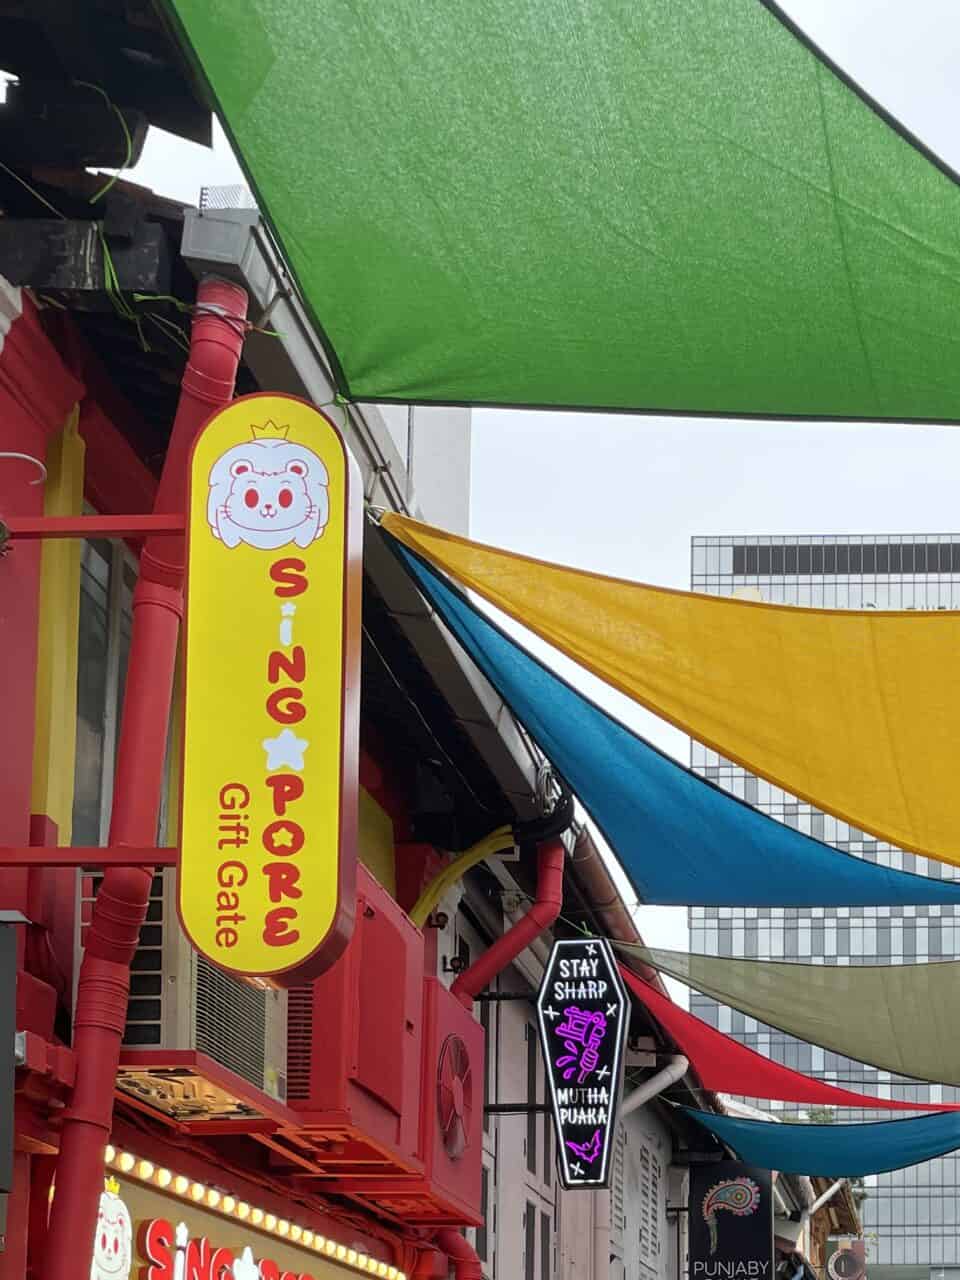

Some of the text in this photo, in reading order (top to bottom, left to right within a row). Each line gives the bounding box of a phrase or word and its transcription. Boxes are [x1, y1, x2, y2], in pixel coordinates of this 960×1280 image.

[216, 782, 250, 949] Gift Gate
[559, 959, 599, 978] STAY
[554, 981, 607, 1001] SHARP
[557, 1087, 609, 1106] MUTHA
[560, 1108, 608, 1126] PUAKA
[694, 1261, 769, 1279] PUNJABY
